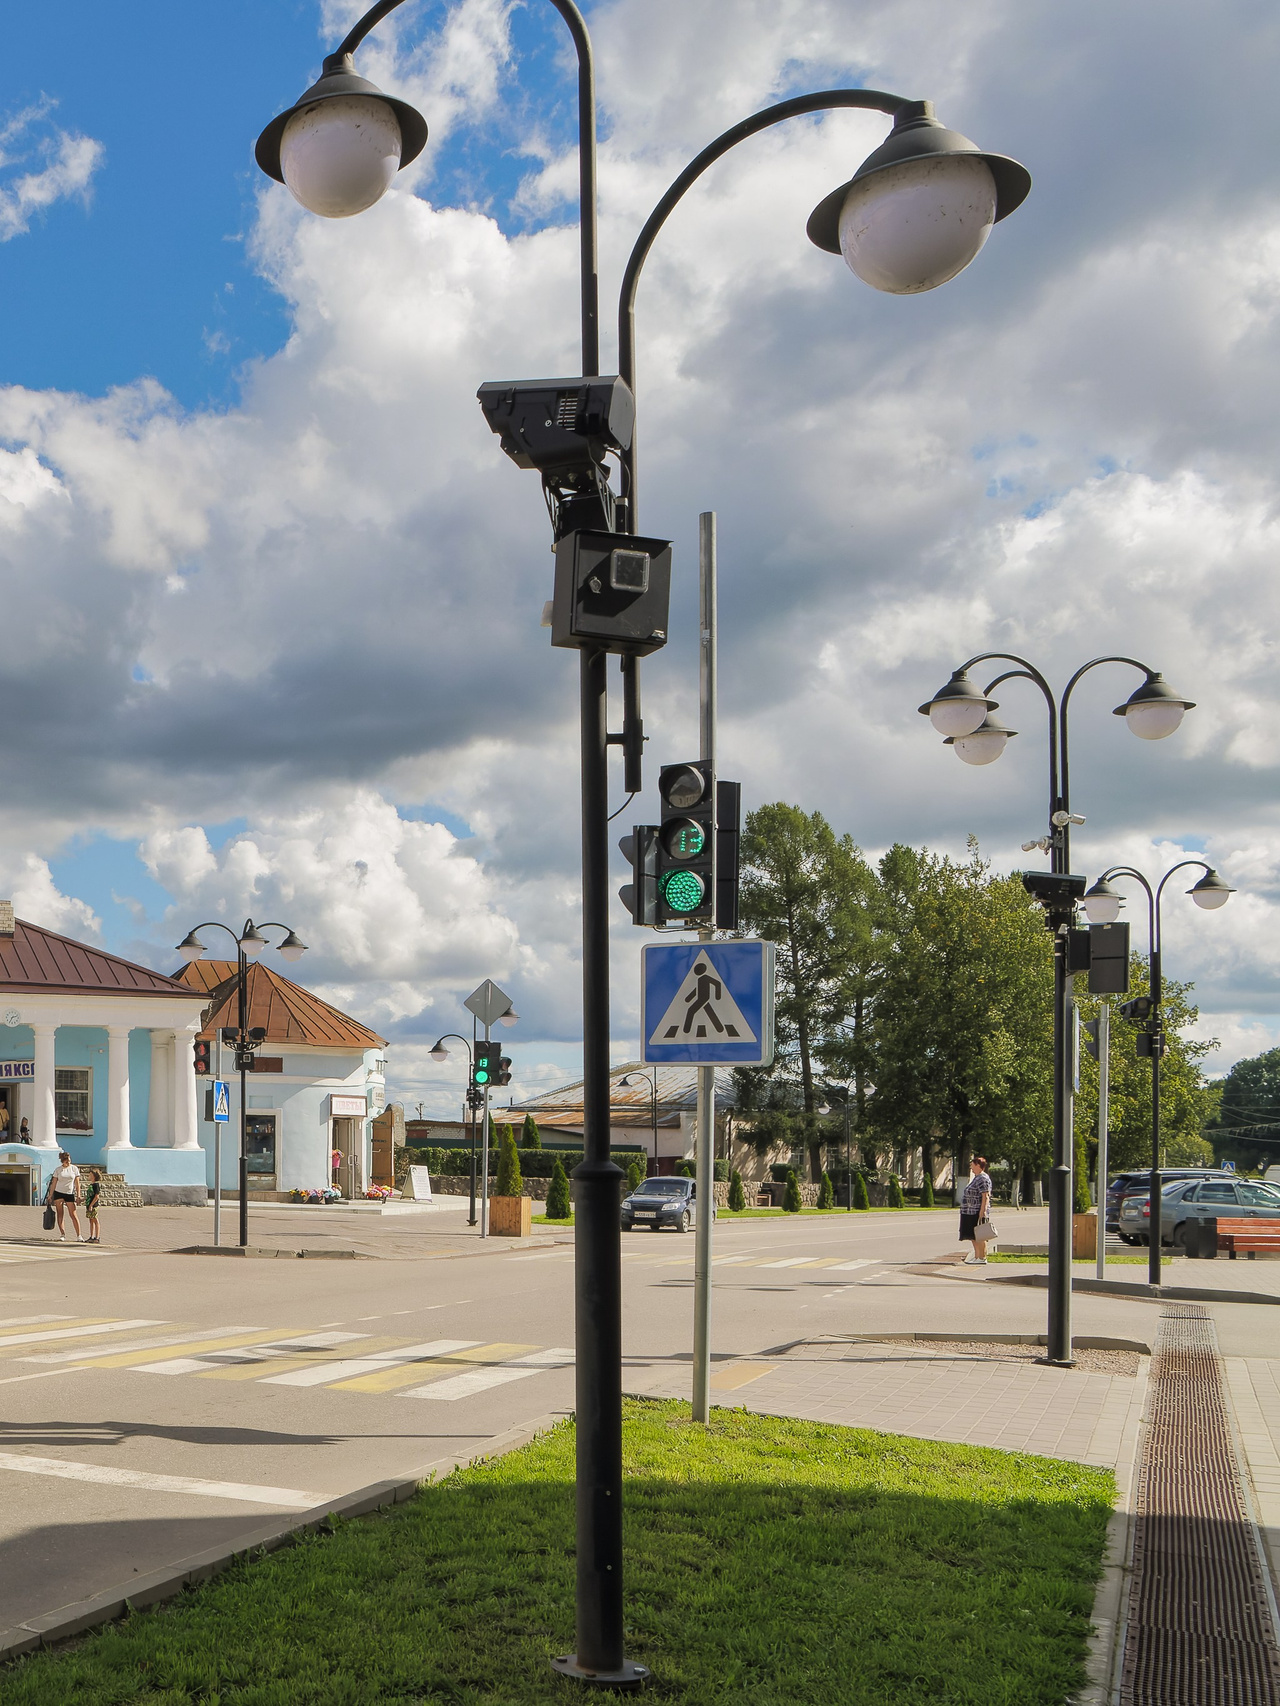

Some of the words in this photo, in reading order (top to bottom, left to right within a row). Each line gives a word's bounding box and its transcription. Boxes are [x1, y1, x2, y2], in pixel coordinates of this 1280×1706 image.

[679, 827, 703, 853] 13
[480, 1058, 488, 1067] 13
[336, 1100, 362, 1111] ЦВЕТЫ
